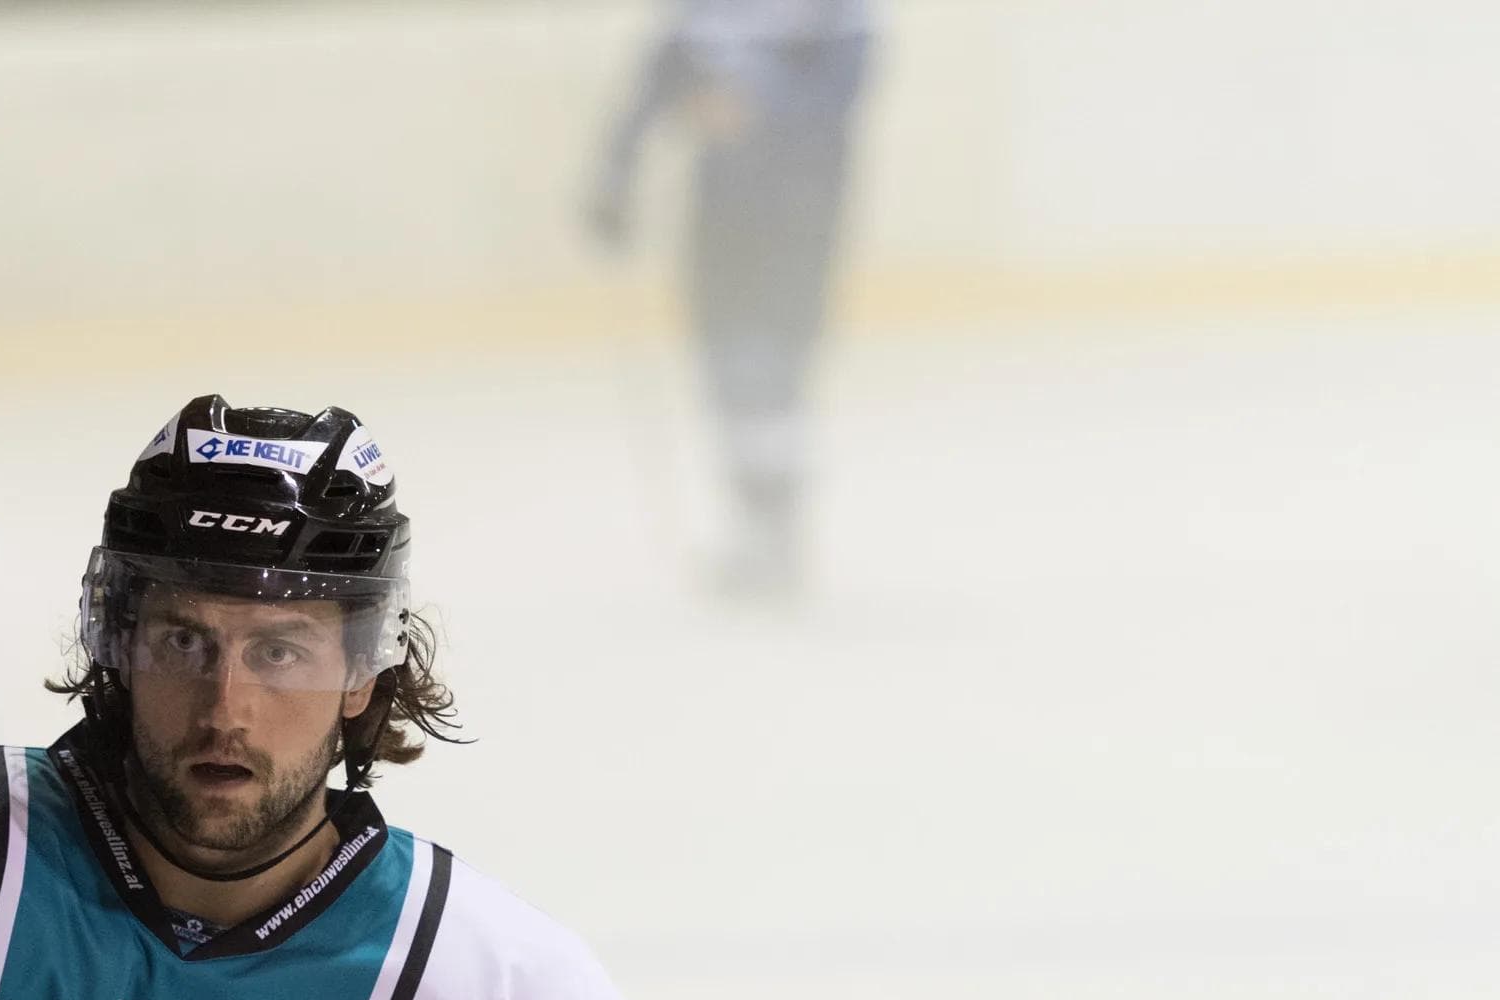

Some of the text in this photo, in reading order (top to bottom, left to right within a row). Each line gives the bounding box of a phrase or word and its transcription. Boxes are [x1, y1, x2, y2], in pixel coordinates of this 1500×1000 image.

[225, 440, 306, 469] KE KELIT
[188, 510, 291, 537] CCM
